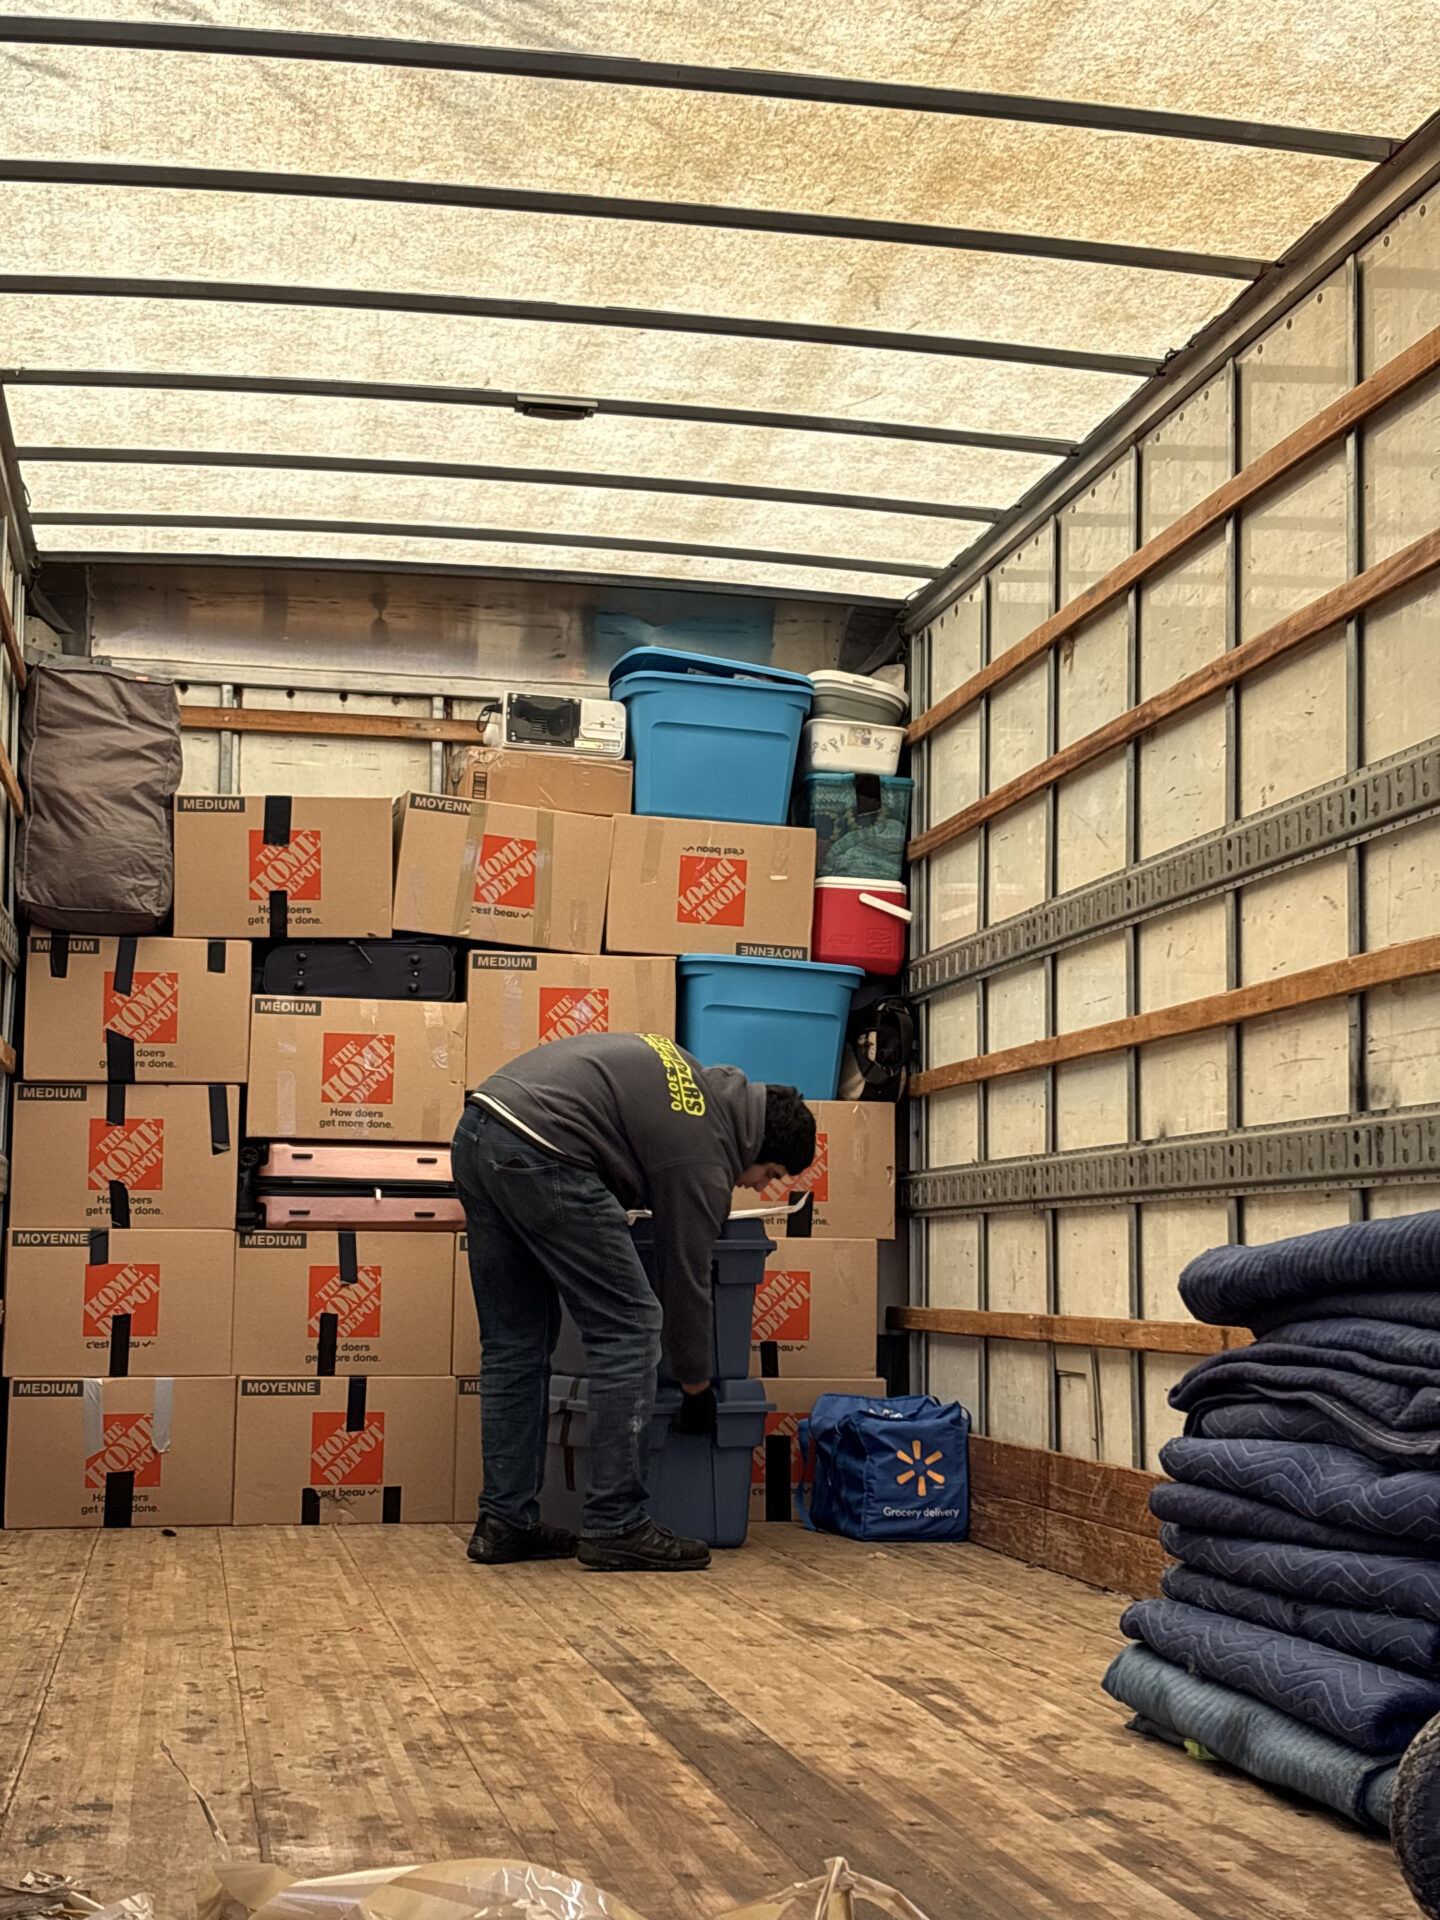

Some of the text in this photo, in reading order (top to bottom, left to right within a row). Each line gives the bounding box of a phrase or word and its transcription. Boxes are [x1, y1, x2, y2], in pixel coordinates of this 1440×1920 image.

[183, 799, 240, 810] MEDIUM
[255, 845, 285, 866] TH
[696, 846, 745, 856] c'est beau
[249, 830, 321, 901] HOME
[475, 839, 528, 887] HOME
[480, 849, 537, 904] DEPOT
[679, 859, 736, 914] DEPOT
[692, 874, 746, 924] HOME
[493, 907, 519, 918] beau
[247, 916, 264, 926] get
[295, 916, 323, 925] done.
[36, 940, 94, 951] MIUM
[741, 945, 803, 959] MOYENNE
[477, 956, 532, 968] MEDIUM
[104, 973, 178, 1037] HOME
[260, 1001, 316, 1013] MEDIUM
[545, 994, 576, 1022] THE
[132, 999, 177, 1043] DEPOT
[136, 1049, 165, 1057] doers
[329, 1041, 360, 1068] THE
[148, 1059, 177, 1068] done.
[322, 1034, 394, 1104] HOME
[349, 1060, 394, 1104] DEPOT
[23, 1088, 81, 1098] MEDIUM
[330, 1108, 383, 1118] How doers
[319, 1119, 336, 1128] get
[366, 1120, 394, 1128] done.
[95, 1127, 128, 1154] THE
[88, 1120, 163, 1190] HOME
[120, 1144, 163, 1189] DEPOT
[789, 1158, 828, 1192] EPOT
[86, 1206, 103, 1216] get
[134, 1206, 164, 1215] done.
[17, 1233, 89, 1244] MOYENNE
[245, 1236, 301, 1246] MEDIUM
[84, 1264, 144, 1320] HOME
[337, 1292, 381, 1337] DEPOT
[752, 1280, 810, 1340] DEPOT
[86, 1341, 109, 1349] c'est
[341, 1342, 370, 1351] doers
[353, 1353, 381, 1362] done.
[18, 1383, 78, 1394] MEDIUM
[247, 1382, 315, 1393] MOYENNE
[103, 1421, 127, 1444] HE
[311, 1420, 368, 1468] HOM
[322, 1421, 384, 1486] DEPOT
[338, 1487, 365, 1496] beau
[81, 1505, 98, 1515] get
[883, 1506, 960, 1518] Grocery delivery
